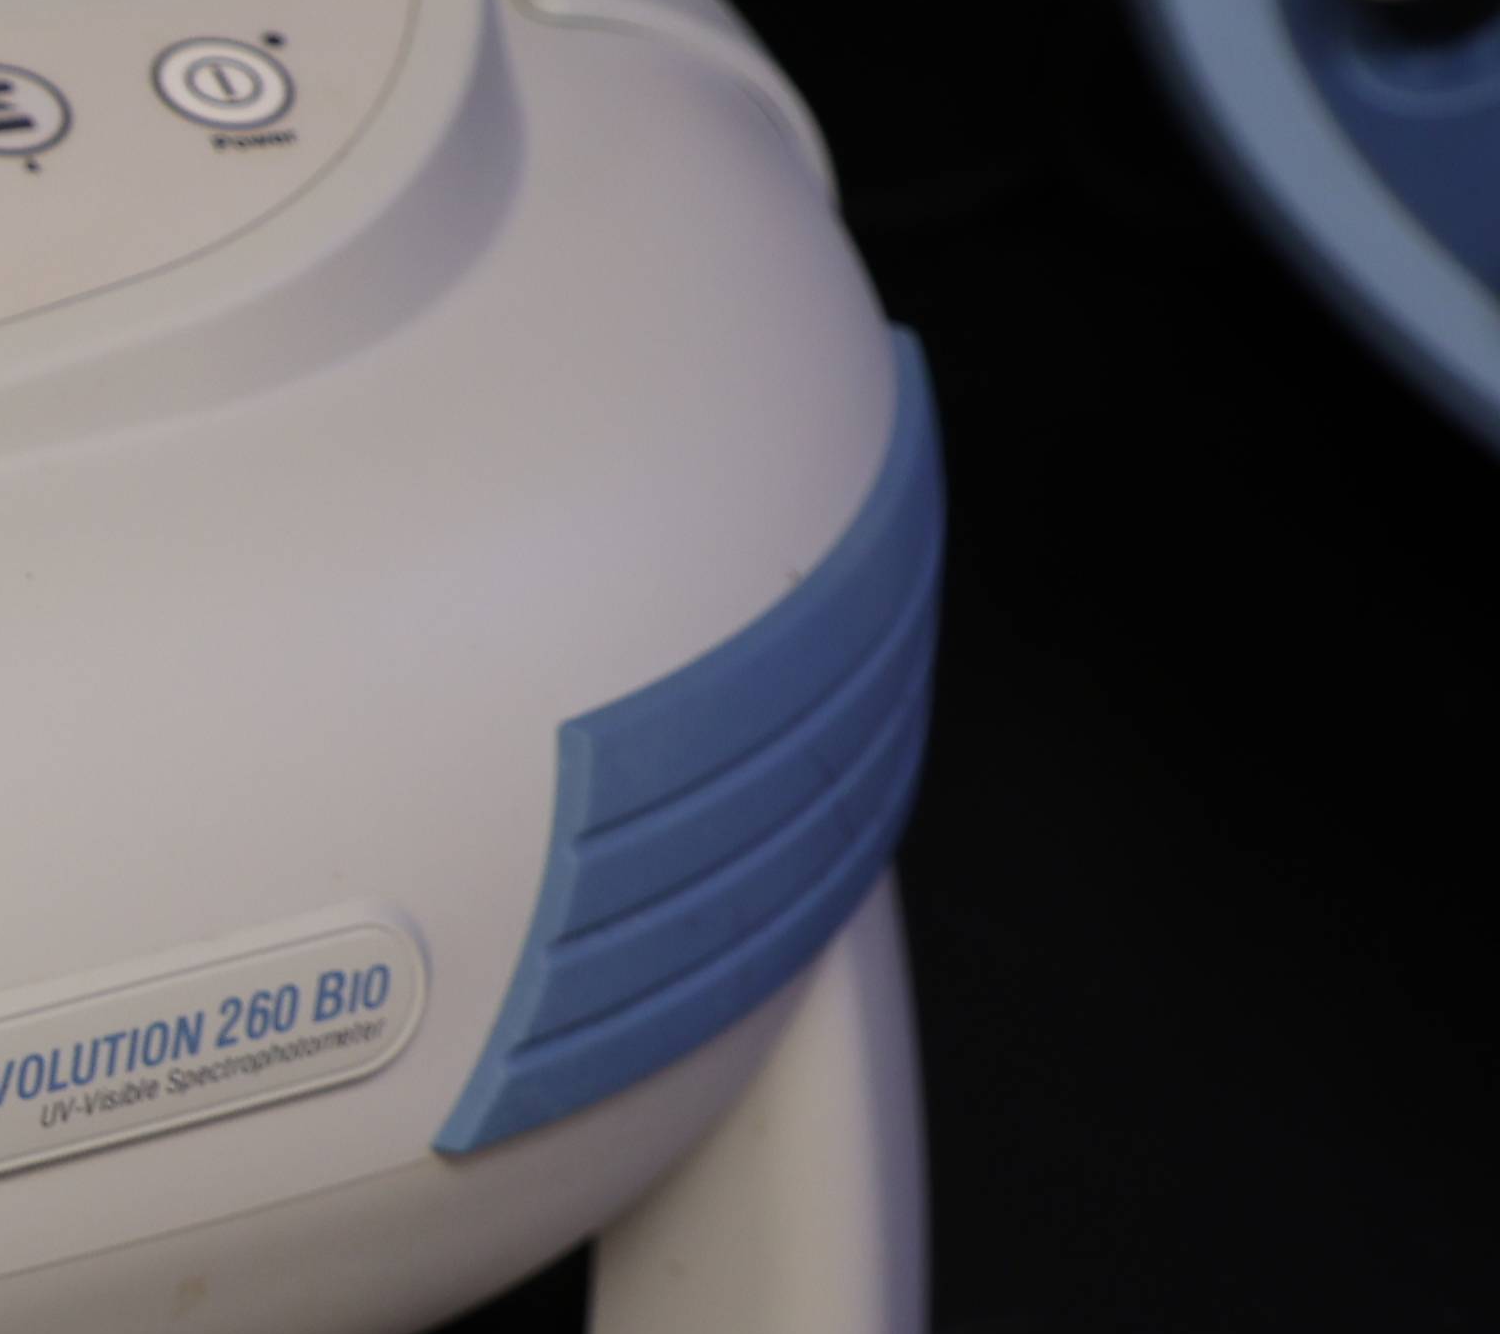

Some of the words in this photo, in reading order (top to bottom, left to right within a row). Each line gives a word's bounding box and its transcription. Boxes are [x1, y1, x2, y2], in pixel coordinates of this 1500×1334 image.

[216, 982, 301, 1050] 260
[39, 1077, 160, 1130] UV-Visible
[166, 1017, 387, 1097] Spectrophotometer
